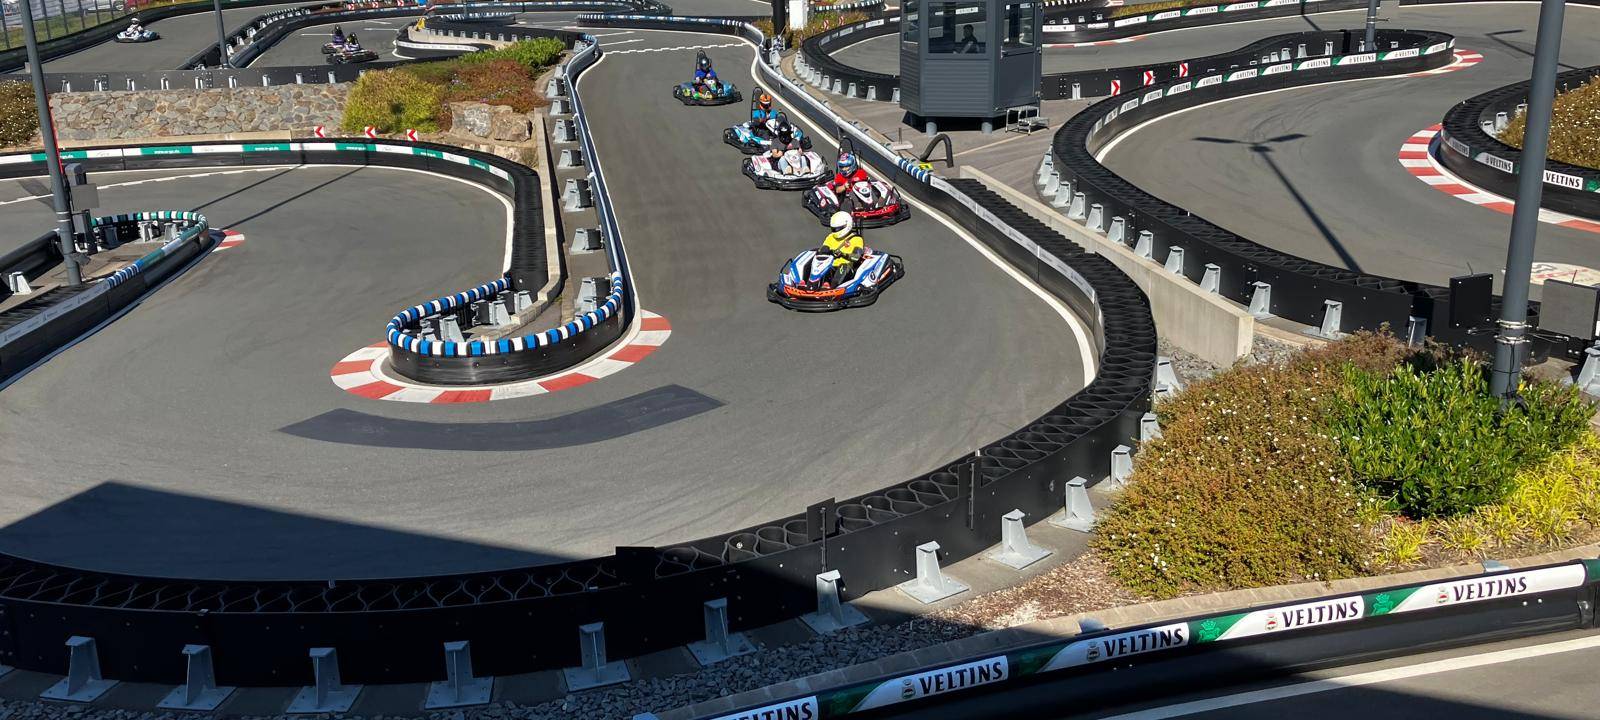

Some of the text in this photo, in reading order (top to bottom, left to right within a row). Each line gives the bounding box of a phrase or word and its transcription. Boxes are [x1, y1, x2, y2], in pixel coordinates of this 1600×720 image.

[1354, 55, 1374, 63] VELTINS
[1489, 156, 1512, 172] VELTINS
[1545, 172, 1580, 188] VELTINS
[1453, 576, 1527, 602] VELTINS
[1282, 600, 1360, 628] VELTINS
[1104, 628, 1185, 657] VELTINS
[919, 661, 1004, 695] VELTINS
